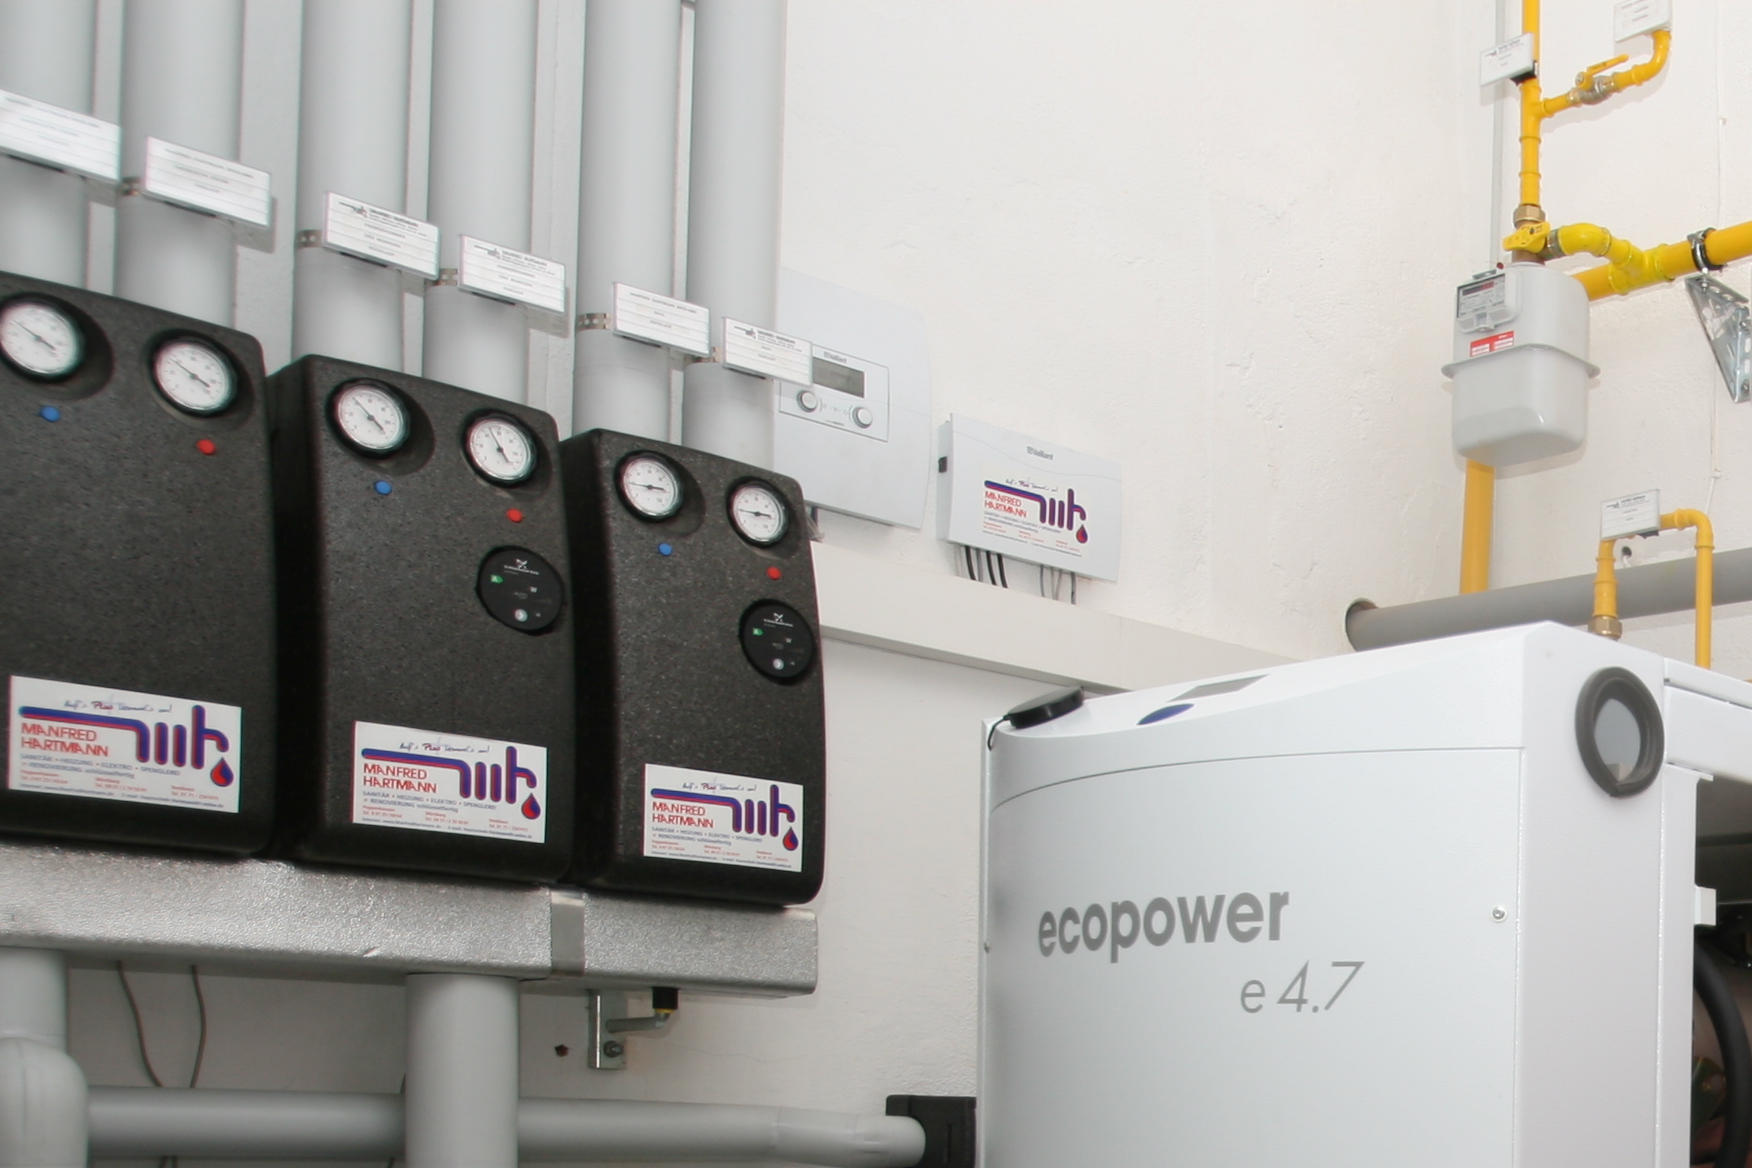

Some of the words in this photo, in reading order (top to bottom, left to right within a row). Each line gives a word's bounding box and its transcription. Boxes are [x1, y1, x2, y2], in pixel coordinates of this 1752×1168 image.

[984, 491, 1022, 508] MANFRED
[984, 500, 1027, 519] HARTMANN
[21, 722, 97, 742] MANFRED
[21, 737, 109, 758] HARTMANN
[363, 763, 428, 780] MANFRED
[363, 776, 437, 793] HARTMANN
[652, 801, 706, 816] MANFRED
[652, 813, 714, 828] HARTMANN
[1037, 890, 1290, 964] ecopower
[1240, 979, 1266, 1014] e
[1276, 961, 1364, 1013] 4.7
